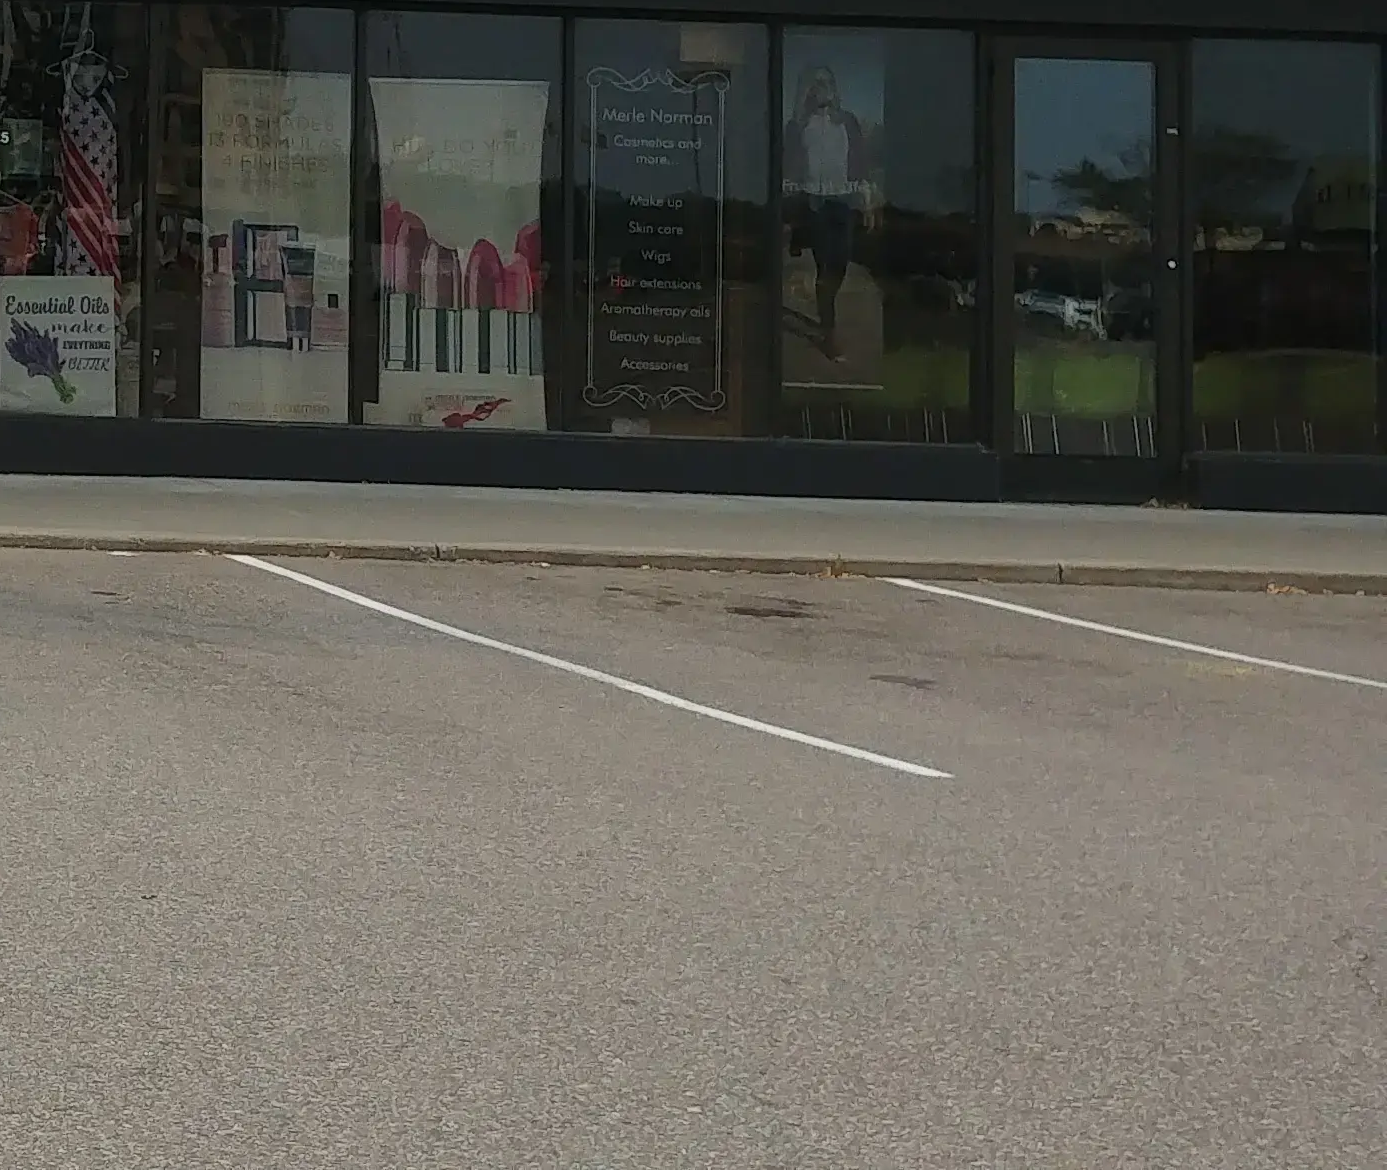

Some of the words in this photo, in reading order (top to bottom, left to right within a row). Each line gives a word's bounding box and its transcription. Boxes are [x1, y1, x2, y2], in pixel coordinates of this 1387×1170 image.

[602, 107, 646, 124] Merle
[650, 108, 713, 126] Norman
[613, 134, 675, 149] Cosmetics
[678, 136, 702, 150] and
[629, 194, 664, 207] Make
[667, 198, 683, 209] up
[628, 220, 653, 234] Skin
[657, 224, 684, 235] care
[641, 249, 672, 264] Wigs
[610, 274, 635, 287] Hair
[640, 278, 702, 290] extensions
[5, 295, 76, 315] Essential
[80, 296, 110, 315] Oils
[600, 302, 687, 319] Aromatherapy
[690, 304, 711, 318] oils
[51, 319, 108, 334] make
[609, 330, 650, 345] Beauty
[653, 332, 703, 346] supplies
[619, 355, 690, 372] Accessories
